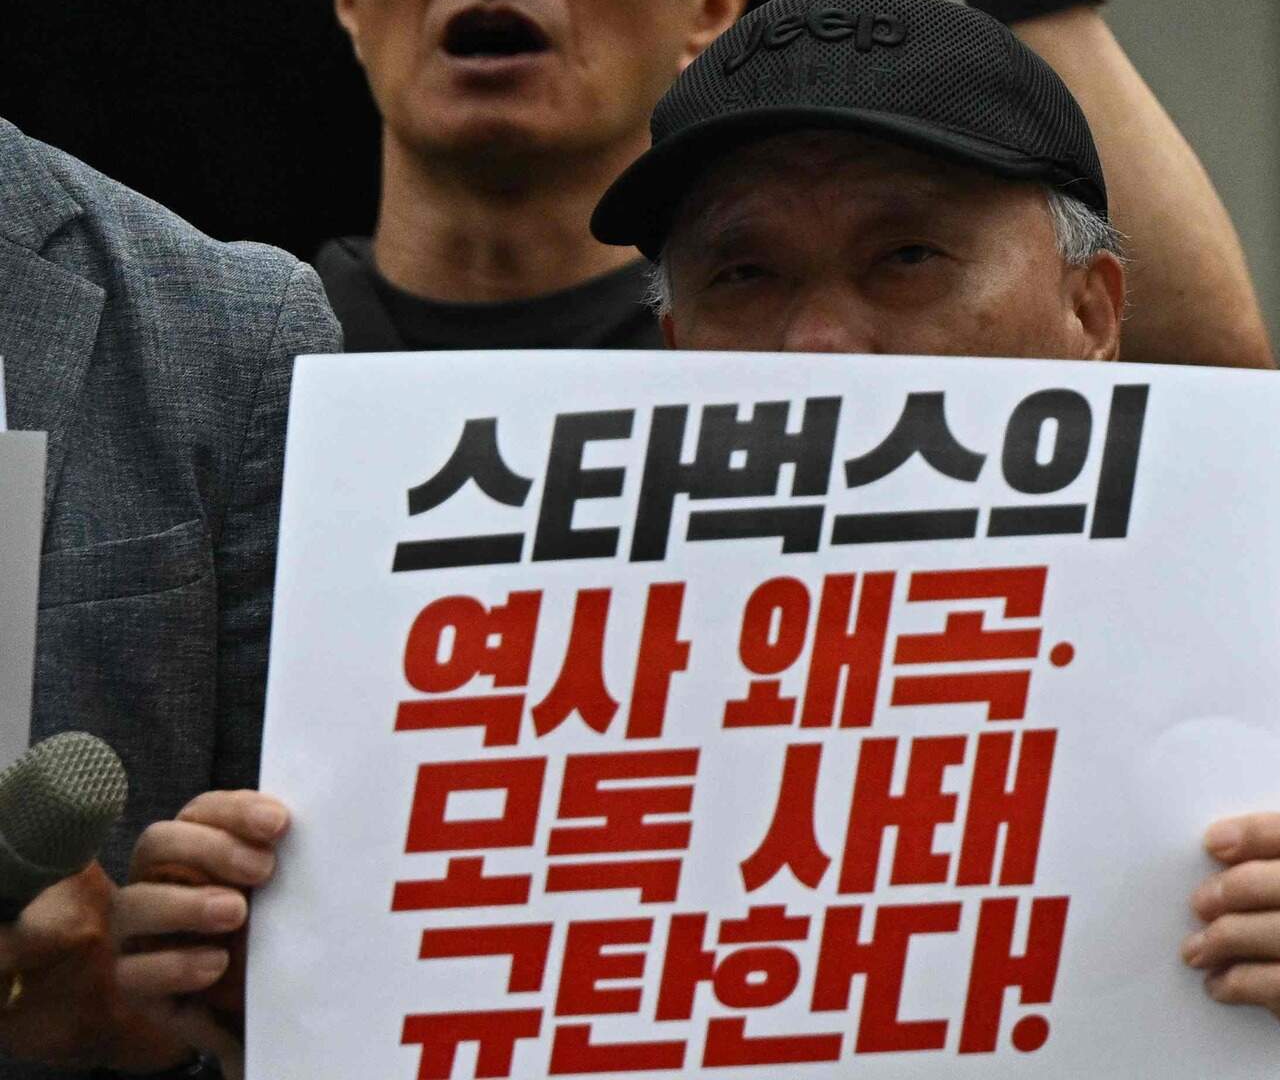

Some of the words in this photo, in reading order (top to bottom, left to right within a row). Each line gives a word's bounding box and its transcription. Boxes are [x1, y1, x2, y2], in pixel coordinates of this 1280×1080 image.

[391, 383, 1150, 572] 스타벅스의
[393, 581, 690, 746] 역사
[391, 748, 700, 913] 모독
[740, 728, 1058, 896] 사태
[400, 895, 1070, 1080] 규탄한다!
